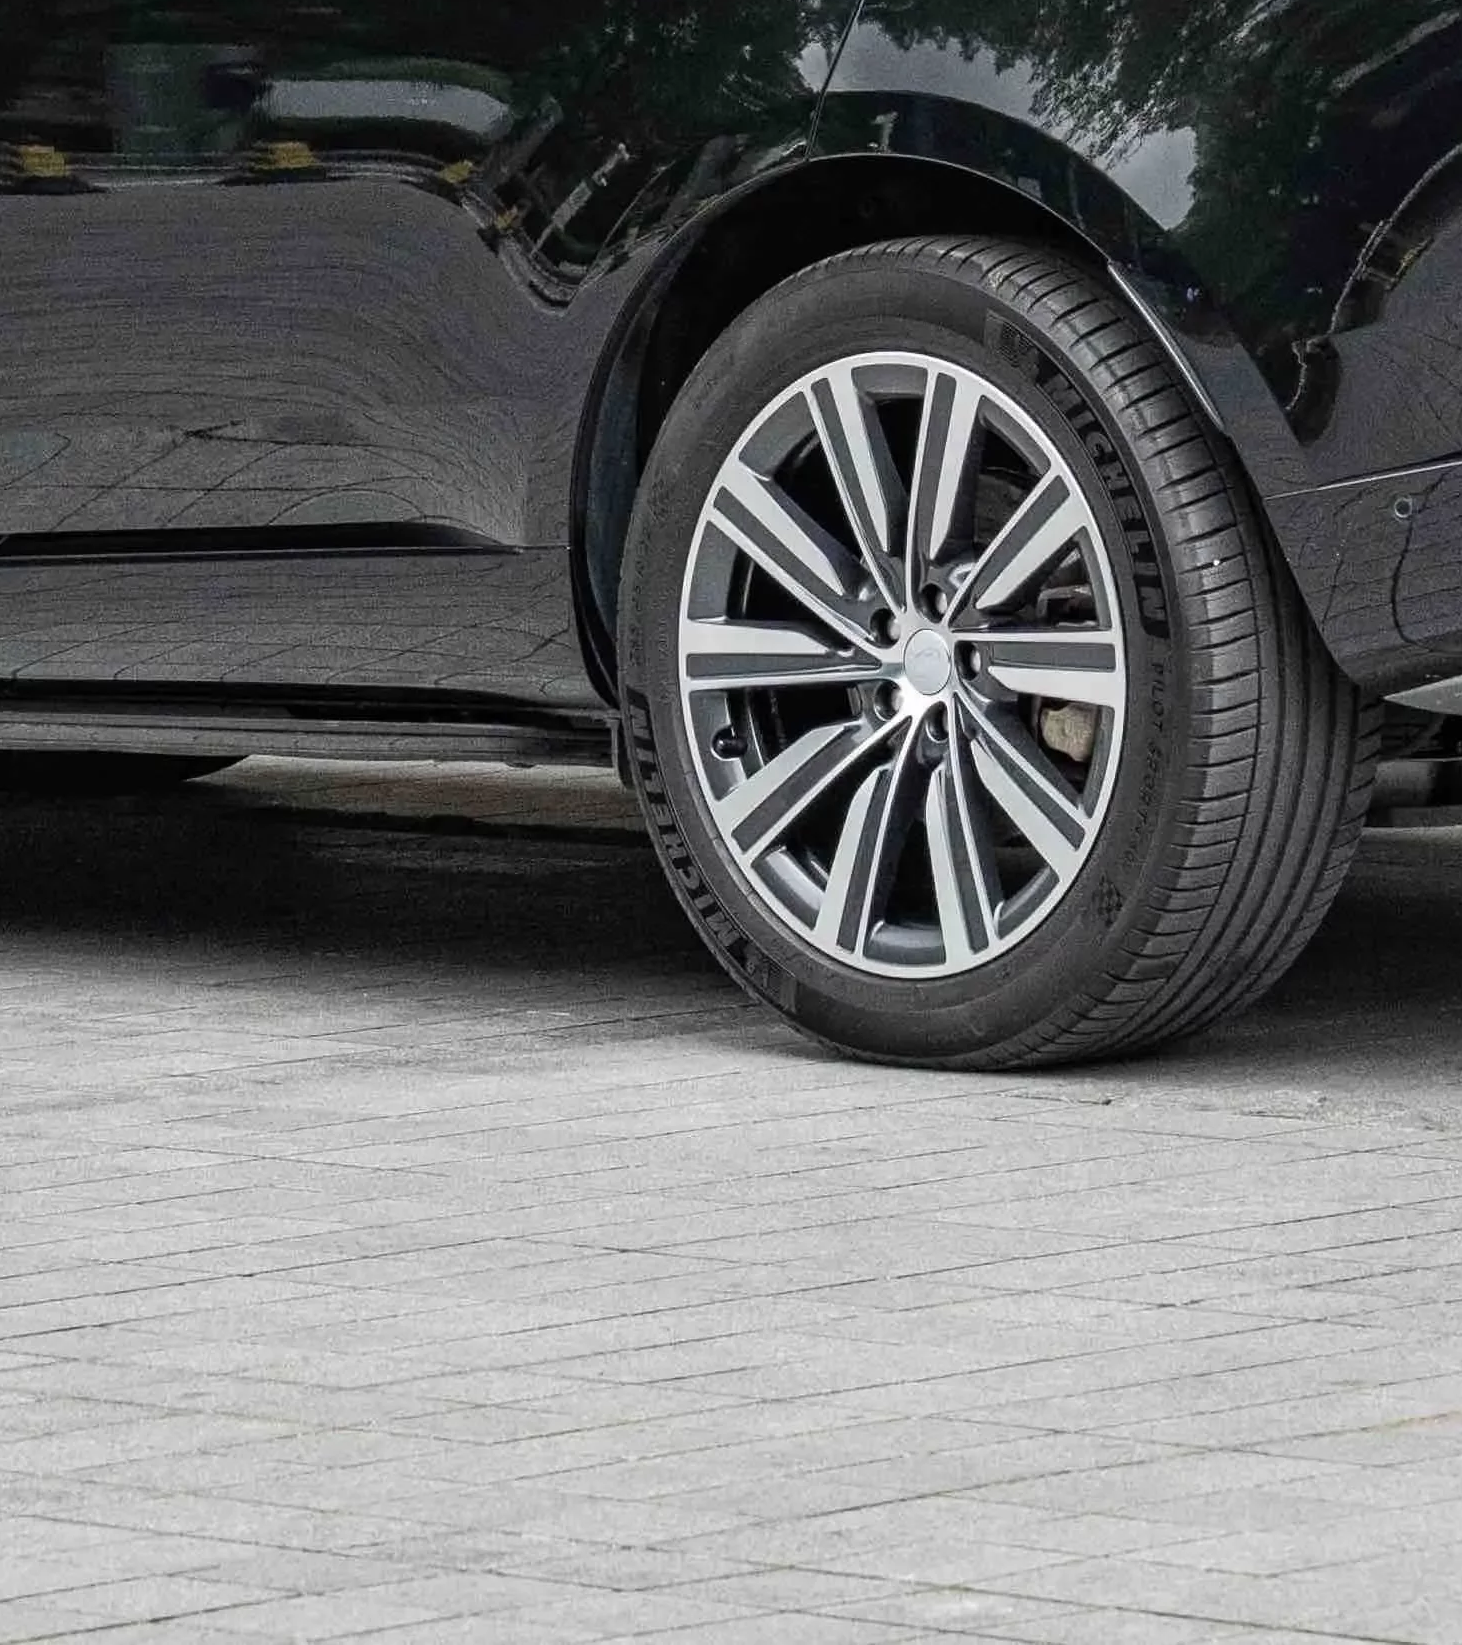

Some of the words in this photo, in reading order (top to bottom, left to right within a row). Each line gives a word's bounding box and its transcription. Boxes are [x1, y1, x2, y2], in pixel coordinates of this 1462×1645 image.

[1039, 372, 1166, 620] MICHELIN
[1150, 663, 1166, 733] PILOT
[629, 703, 741, 950] MICHELIN
